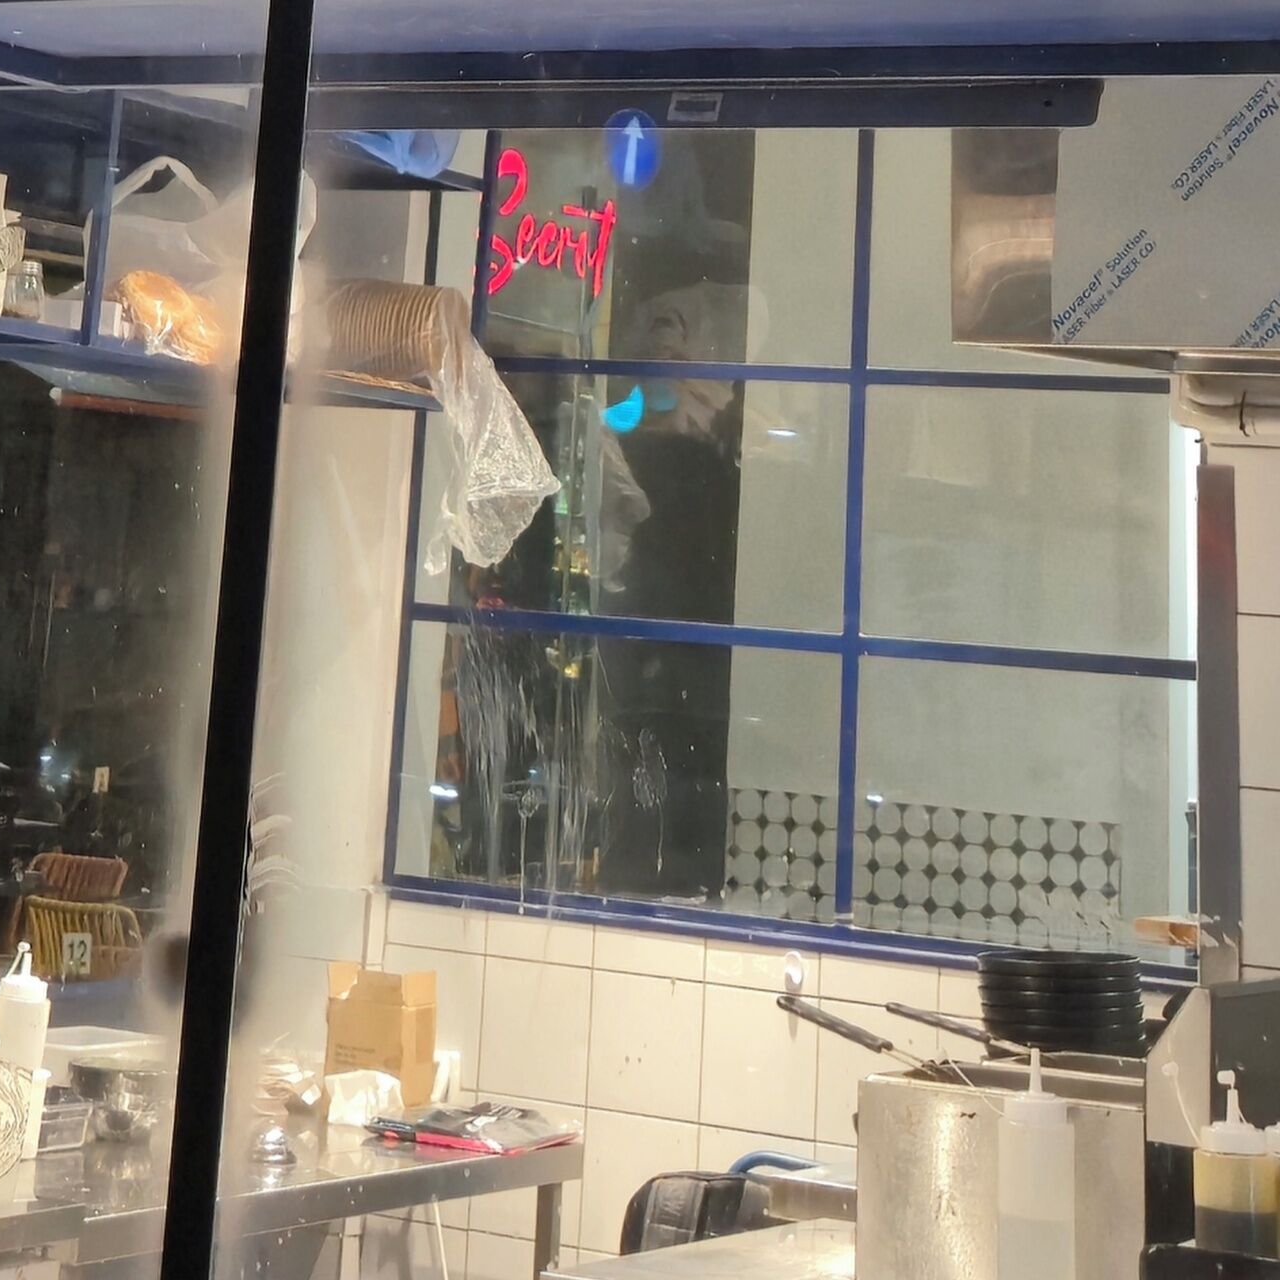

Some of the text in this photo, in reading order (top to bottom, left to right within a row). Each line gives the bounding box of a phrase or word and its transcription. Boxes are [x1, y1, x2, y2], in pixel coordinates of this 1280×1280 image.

[1243, 79, 1276, 113] LASER
[1189, 141, 1219, 174] LASER
[1181, 157, 1224, 201] Solution
[1105, 228, 1148, 272] Solution
[1111, 257, 1140, 289] LASER
[1250, 299, 1280, 331] LASER
